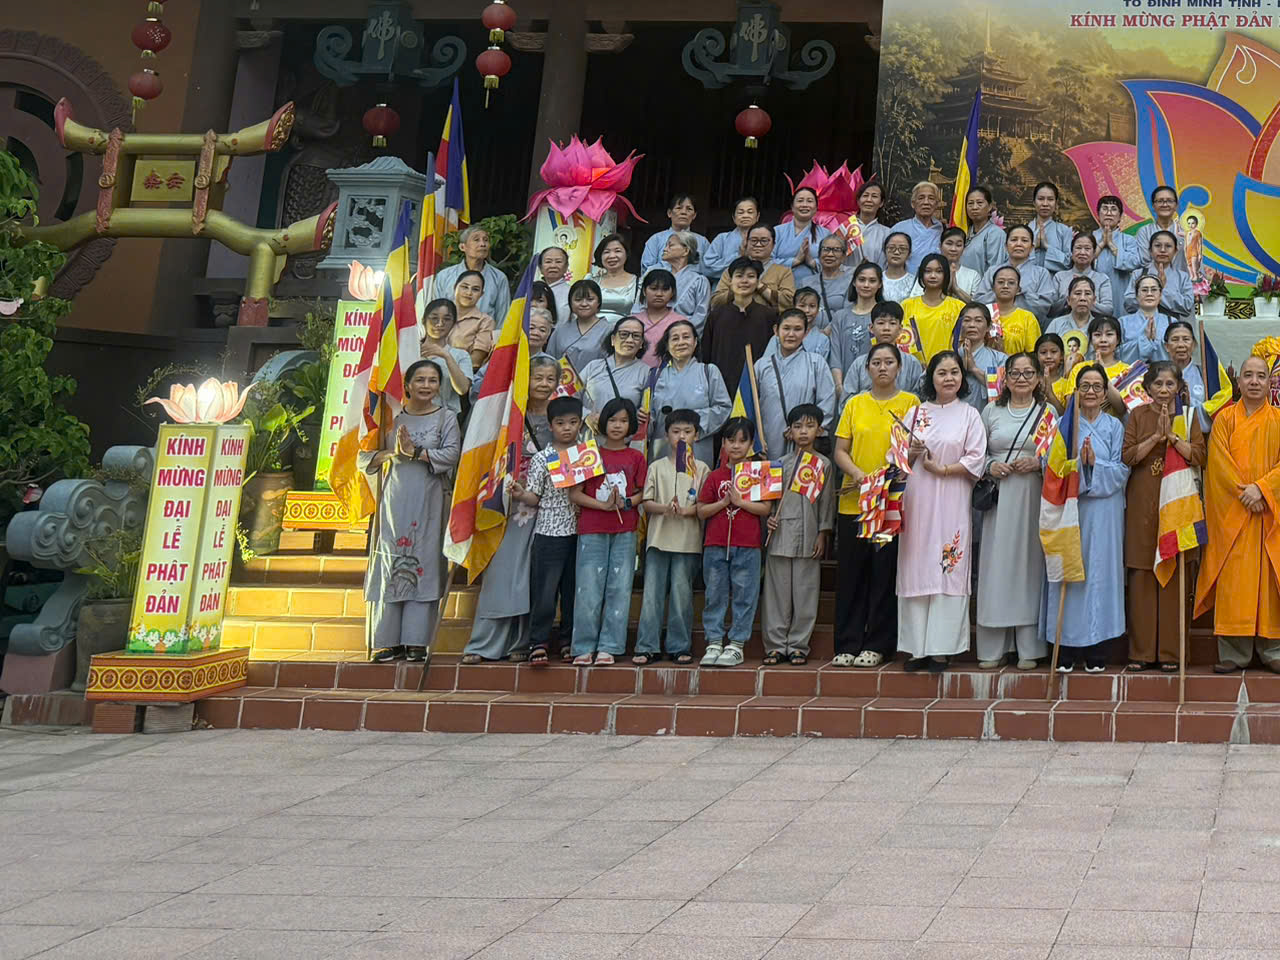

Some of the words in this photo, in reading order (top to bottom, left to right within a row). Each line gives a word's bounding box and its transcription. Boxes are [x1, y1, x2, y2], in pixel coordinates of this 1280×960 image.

[1187, 0, 1223, 8] MINH
[1229, 0, 1261, 10] TỊNH
[1070, 10, 1116, 28] KÍNH
[1122, 11, 1175, 28] MỪNG
[1181, 11, 1229, 30] PHẬT
[1236, 10, 1272, 28] ĐẢN
[166, 435, 206, 456] KÍNH
[220, 435, 244, 456] KÍNH
[158, 465, 206, 487] MỪNG
[213, 467, 242, 487] MỪNG
[164, 500, 191, 522] ĐẠI
[215, 500, 232, 521] ĐẠI
[162, 526, 182, 550] LỄ
[213, 525, 225, 549] LỄ
[146, 560, 188, 586] PHẬT
[202, 558, 227, 584] PHẬT
[145, 589, 180, 613] ĐẢN
[200, 588, 220, 612] ĐẢN
